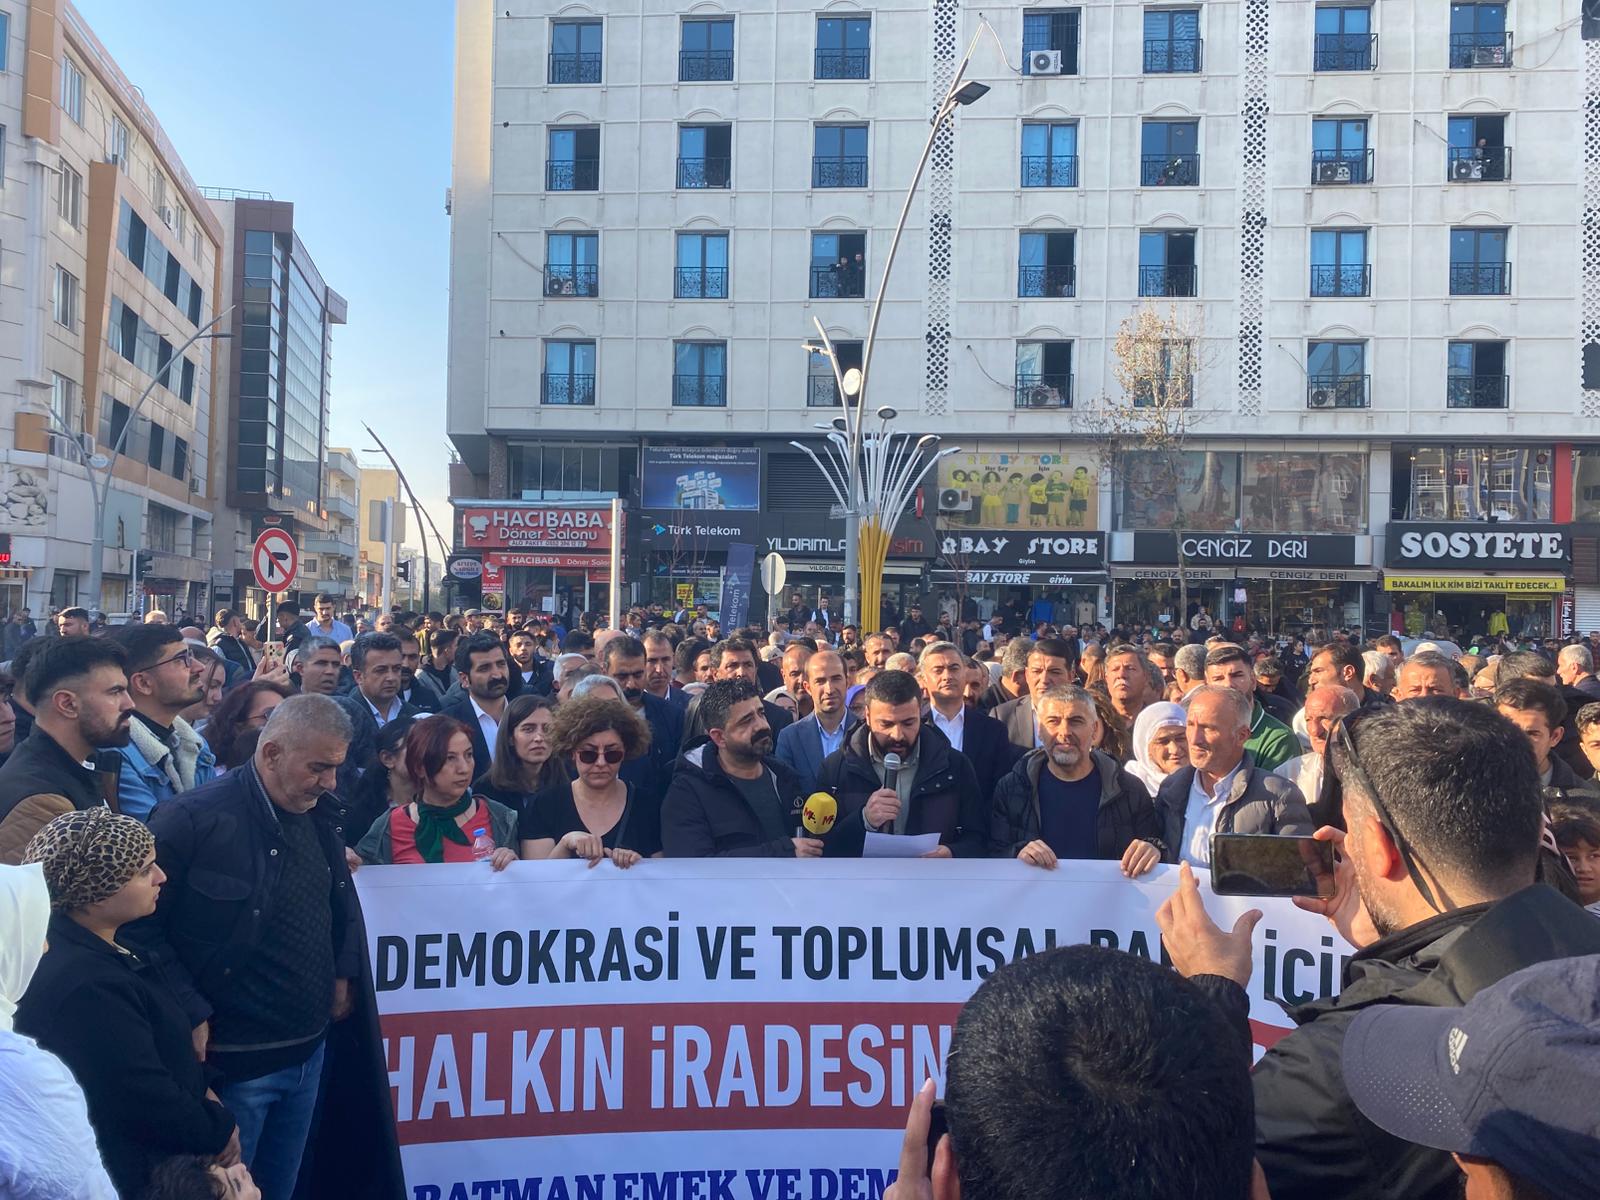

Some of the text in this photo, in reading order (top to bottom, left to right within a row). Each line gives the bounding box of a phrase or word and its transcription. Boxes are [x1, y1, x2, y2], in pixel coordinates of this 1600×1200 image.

[493, 510, 604, 528] HACIBABA
[500, 527, 598, 540] Döner Salonu
[668, 525, 741, 535] Türk Telekom
[1028, 537, 1098, 555] STORE
[1400, 531, 1563, 559] SOSYETE
[511, 556, 561, 565] HACIBABA
[567, 558, 589, 566] Döner
[991, 573, 1031, 584] STORE
[1049, 574, 1073, 584] GİYİM
[1392, 581, 1431, 589] BAKALIM
[1433, 580, 1446, 589] İLK
[1448, 580, 1464, 589] KİM
[1465, 580, 1483, 589] BİZİ
[1484, 580, 1515, 589] TAKLİT
[727, 589, 741, 627] Telekom
[376, 911, 680, 992] DEMOKRASİ
[697, 925, 756, 979] VE
[382, 1026, 624, 1122] HALKIN
[613, 1169, 739, 1200] EMEK
[744, 1168, 801, 1200] VE
